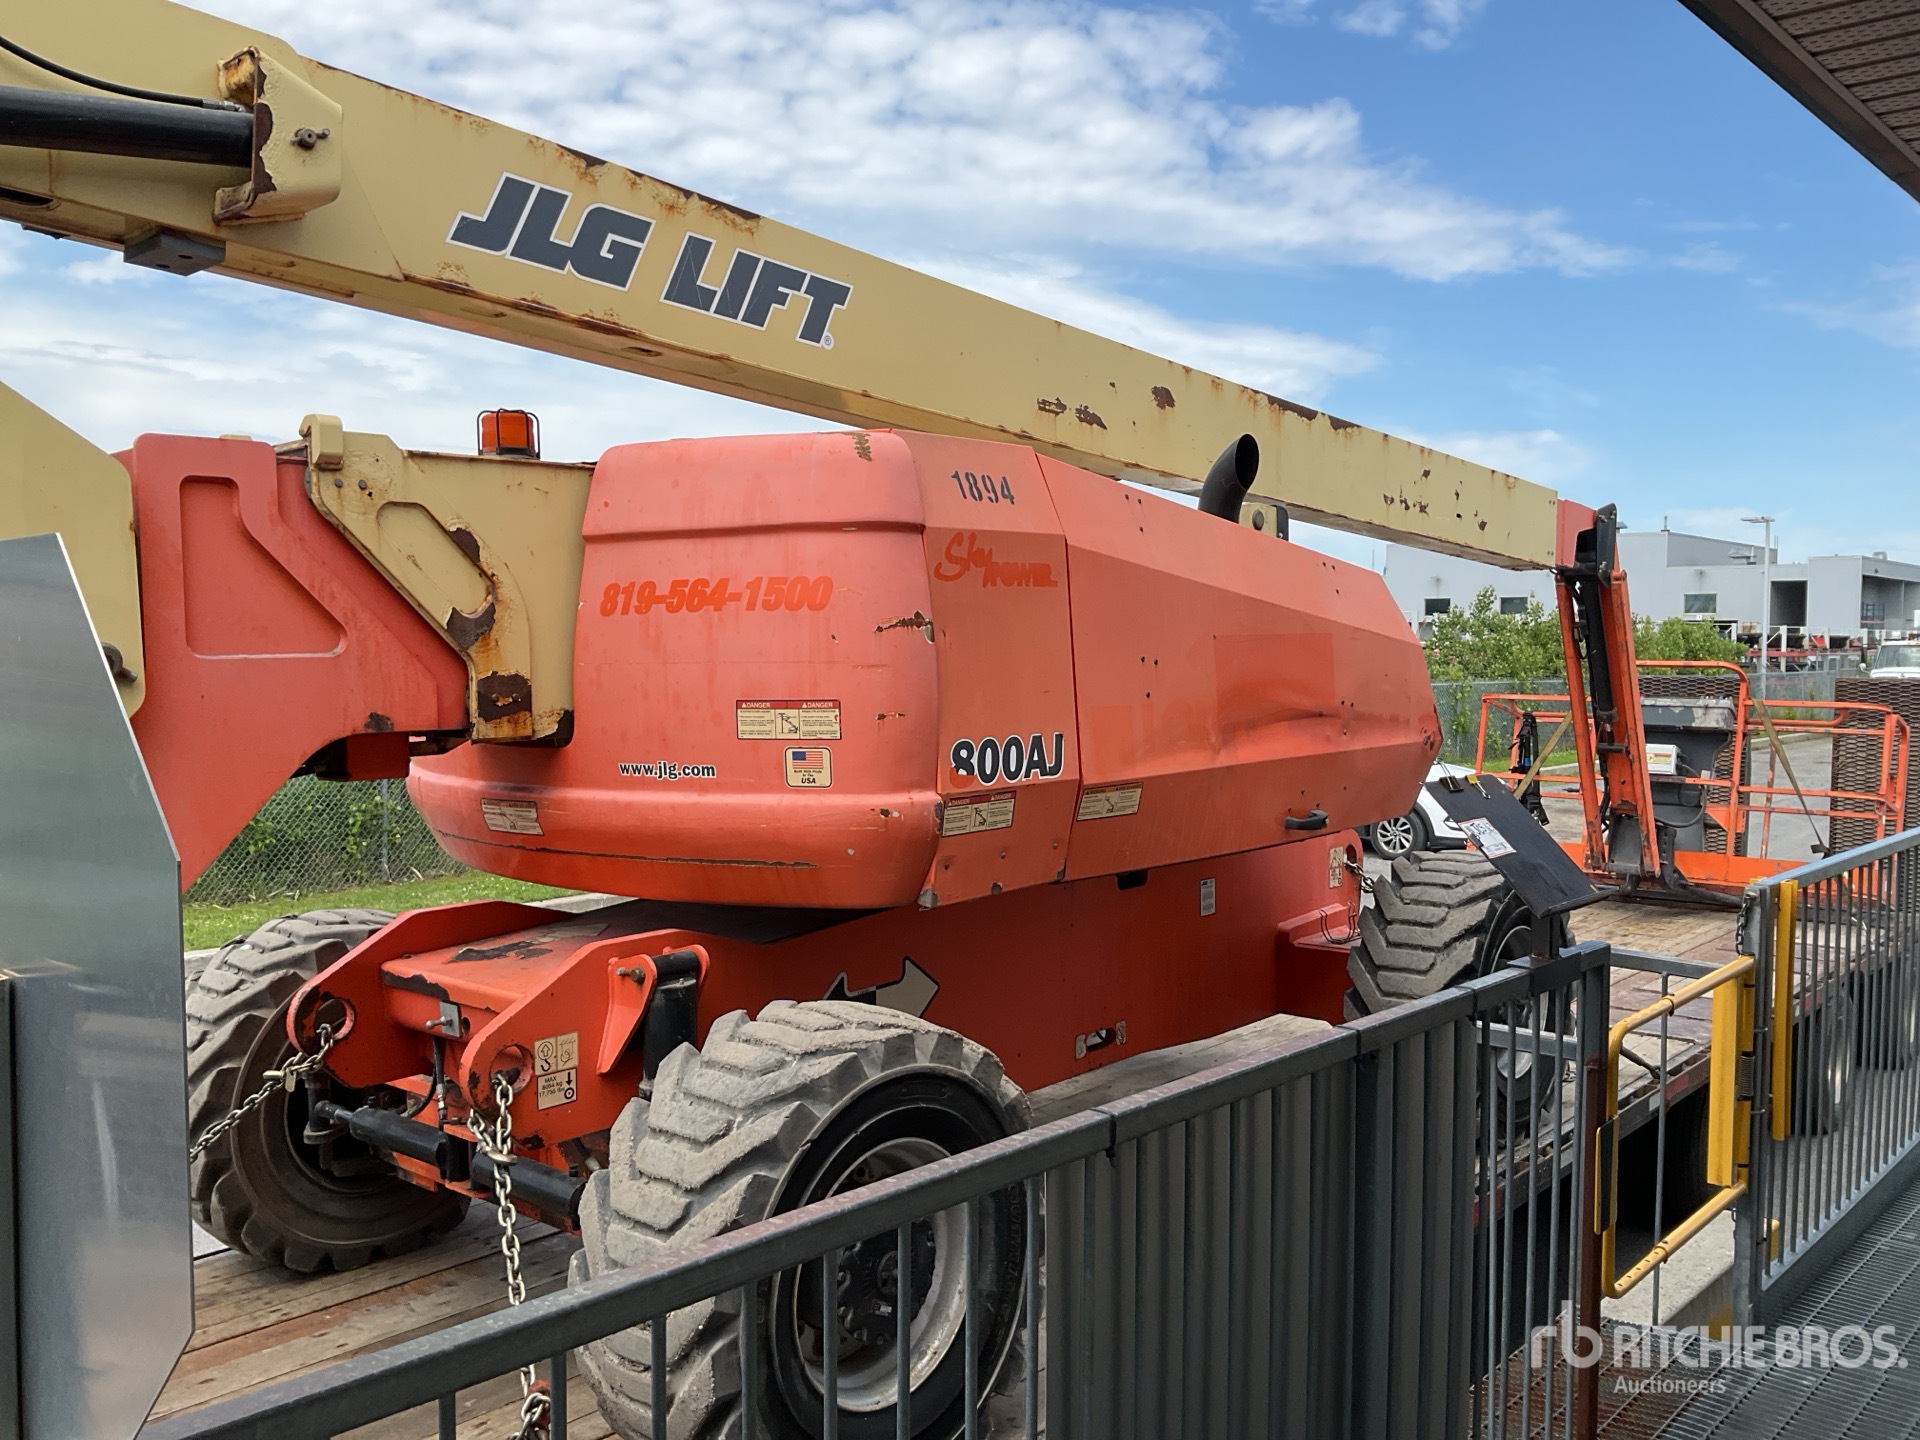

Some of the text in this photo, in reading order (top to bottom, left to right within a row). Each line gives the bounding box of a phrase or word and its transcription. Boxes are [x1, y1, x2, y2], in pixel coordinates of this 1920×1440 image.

[446, 172, 854, 347] JLG LIFT
[951, 470, 1015, 505] 1894
[600, 575, 833, 617] 819-564-1500
[618, 761, 717, 780] www.jlg.com
[950, 731, 1064, 787] 800AJ
